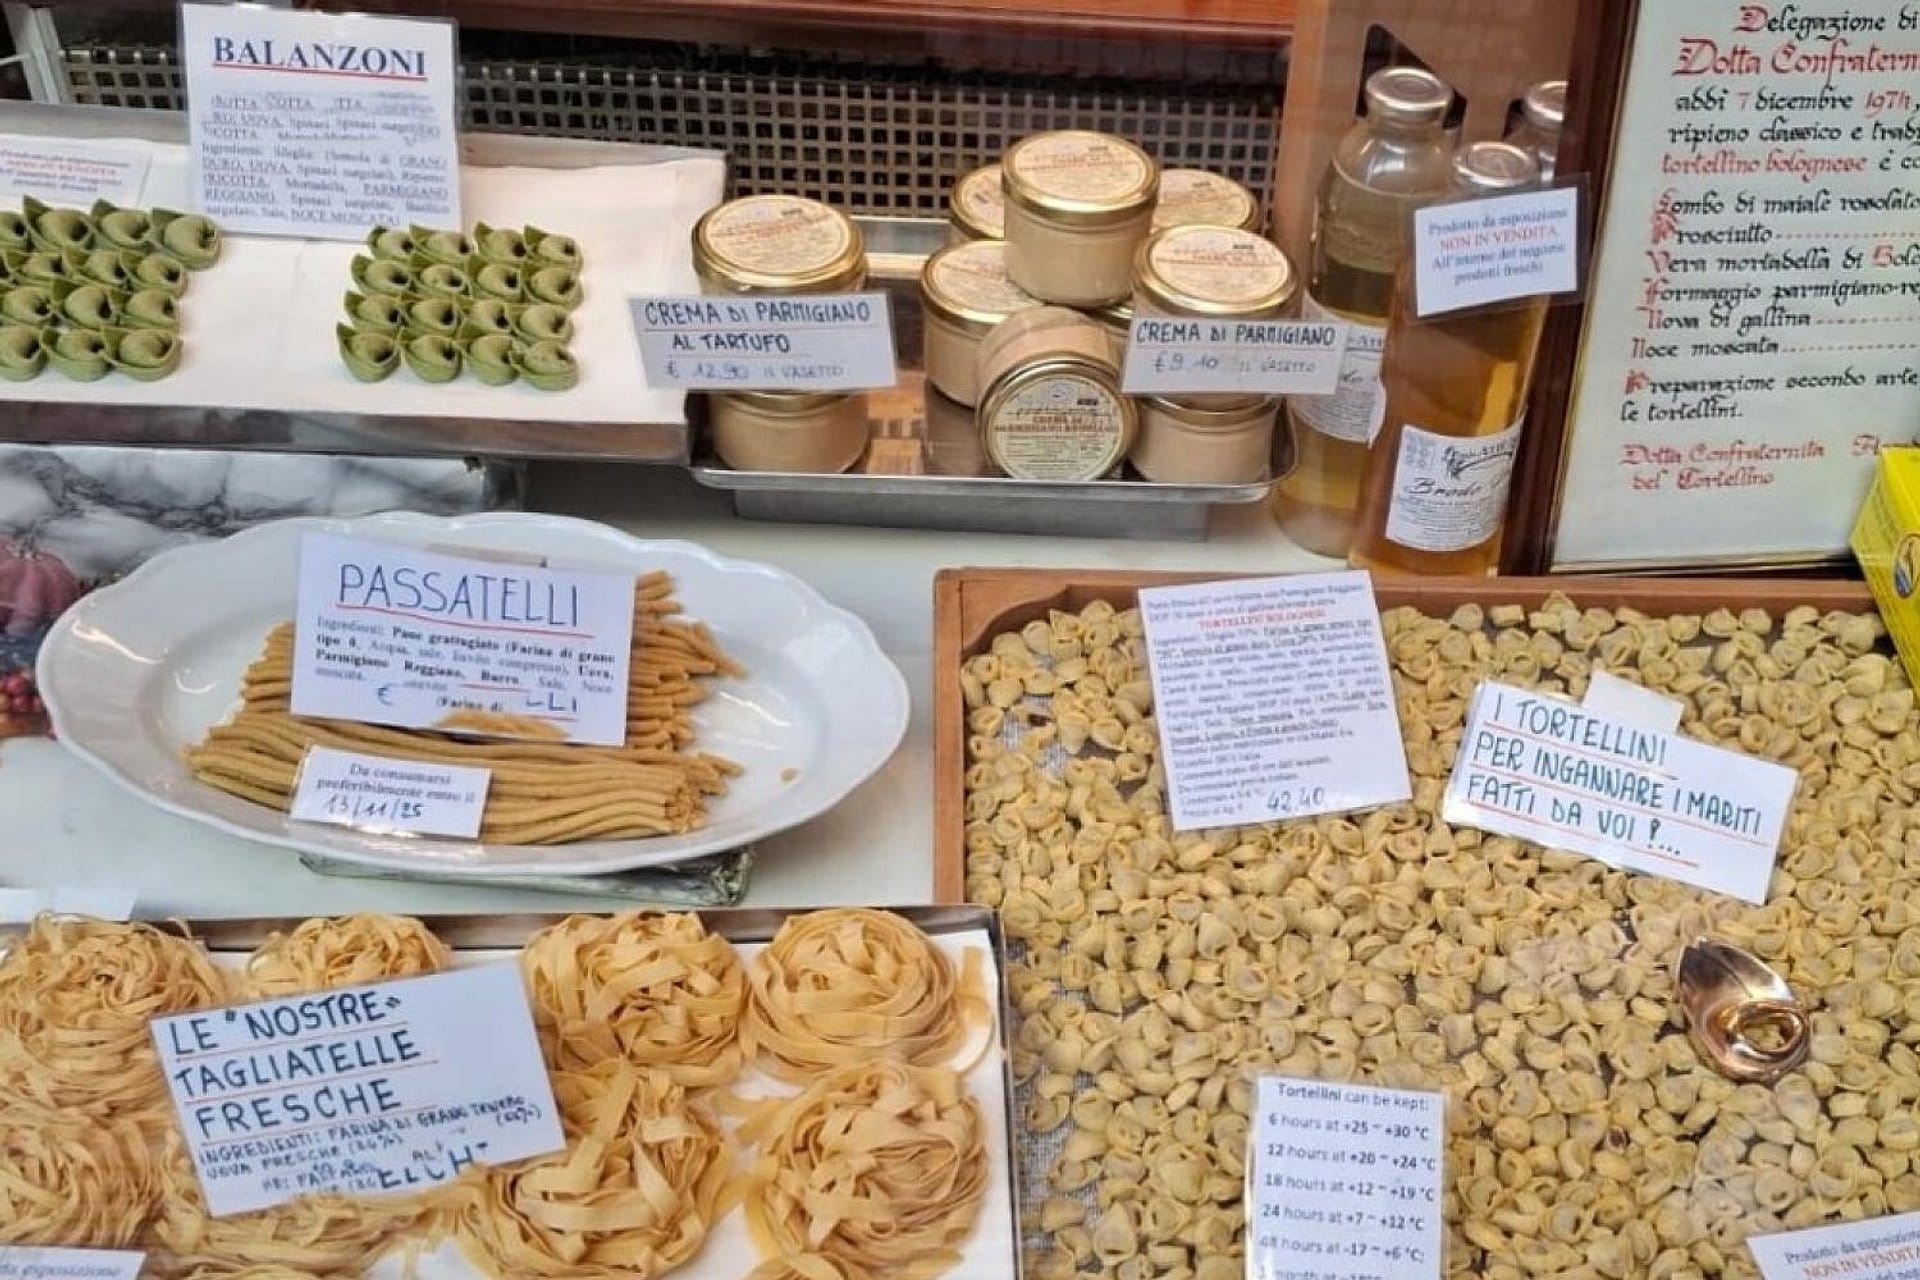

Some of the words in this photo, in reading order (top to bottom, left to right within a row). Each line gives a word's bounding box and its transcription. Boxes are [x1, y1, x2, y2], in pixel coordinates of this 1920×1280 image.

[1733, 4, 1886, 41] Delegazione
[1898, 4, 1918, 30] di
[213, 36, 426, 76] BALANZONI
[1672, 38, 1761, 76] Dotta
[1738, 91, 1749, 111] 7
[1755, 85, 1853, 112] dicembre
[1668, 122, 1749, 152] ripieno
[1759, 116, 1842, 142] classico
[1851, 126, 1863, 141] e
[1661, 149, 1761, 175] tortellino
[1766, 148, 1868, 183] bolognese
[1735, 190, 1755, 213] di
[1763, 188, 1832, 213] maiale
[1428, 219, 1479, 236] Prodotto
[1482, 214, 1496, 228] da
[1440, 234, 1471, 250] NON
[1475, 233, 1489, 247] IN
[1494, 225, 1558, 244] VENDITA
[1652, 211, 1774, 245] Prosciutto
[1499, 246, 1516, 262] del
[1646, 250, 1708, 274] Vera
[1717, 247, 1831, 273] mortadella
[1843, 247, 1865, 270] di
[1643, 278, 1763, 310] Formaggio
[644, 301, 722, 326] CREMA
[754, 300, 871, 324] PARMIGIANO
[1710, 304, 1732, 329] di
[1737, 306, 1811, 336] gallina
[672, 334, 696, 351] AL
[700, 334, 791, 354] TARTUFO
[1135, 322, 1201, 345] CREMA
[1209, 326, 1227, 342] DI
[1233, 323, 1338, 347] PARMIGIANO
[1630, 337, 1679, 359] Noce
[1691, 336, 1780, 357] moscata
[666, 361, 681, 379] €
[780, 364, 846, 380] VASETTO
[1624, 368, 1776, 402] Preparazione
[1785, 366, 1867, 389] secondo
[1876, 366, 1920, 387] arte
[1620, 400, 1639, 421] le
[1648, 396, 1743, 421] tortellini.
[1688, 440, 1825, 468] Confraternita
[1630, 468, 1669, 490] del
[1676, 466, 1775, 491] Tortellino
[338, 563, 579, 628] PASSATELLI
[315, 633, 341, 648] tipo
[392, 625, 424, 641] Pane
[428, 632, 501, 653] grattugiato
[504, 640, 554, 658] (Farina
[560, 645, 574, 659] di
[315, 648, 390, 668] Parmigiano
[404, 659, 466, 680] Reggiano,
[1494, 693, 1503, 722] I
[1515, 697, 1668, 767] TORTELLINI
[349, 763, 371, 777] Da
[373, 766, 451, 785] consumarsi
[1473, 730, 1526, 770] PER
[1533, 749, 1665, 810] INGANNARE
[1673, 787, 1682, 813] I
[1686, 790, 1763, 835] MARITI
[316, 778, 424, 800] preferibilmente
[426, 790, 462, 802] entro
[1467, 773, 1537, 815] FATTI
[1551, 797, 1582, 827] DA
[1597, 809, 1637, 842] VOI
[169, 1017, 220, 1056] LE
[173, 1029, 422, 1099] TAGLIATELLE
[194, 1078, 402, 1140] FRESCHE
[1278, 1083, 1342, 1101] Tortellini
[1344, 1092, 1370, 1105] can
[1374, 1094, 1391, 1107] be
[1393, 1095, 1430, 1112] kept:
[1268, 1112, 1278, 1126] 6
[1281, 1113, 1322, 1129] hours
[1325, 1119, 1340, 1132] at
[1343, 1120, 1369, 1135] +25
[1384, 1123, 1411, 1138] +30
[198, 1131, 321, 1165] INGREDIENTI:
[327, 1117, 390, 1141] FARINA
[1267, 1142, 1283, 1157] 12
[1286, 1144, 1328, 1161] hours
[1331, 1150, 1346, 1162] at
[1349, 1151, 1377, 1166] +20
[1392, 1155, 1418, 1170] +24
[1265, 1172, 1283, 1187] 18
[1285, 1174, 1327, 1191] hours
[1329, 1180, 1345, 1192] at
[1349, 1181, 1375, 1196] +12
[1389, 1185, 1416, 1200] +19
[1262, 1203, 1281, 1218] 24
[1283, 1205, 1324, 1222] hours
[1327, 1210, 1342, 1224] at
[1346, 1211, 1365, 1225] +7
[1379, 1215, 1406, 1230] +12
[1280, 1236, 1322, 1253] hours
[1325, 1241, 1341, 1255] at
[1382, 1247, 1402, 1261] +6
